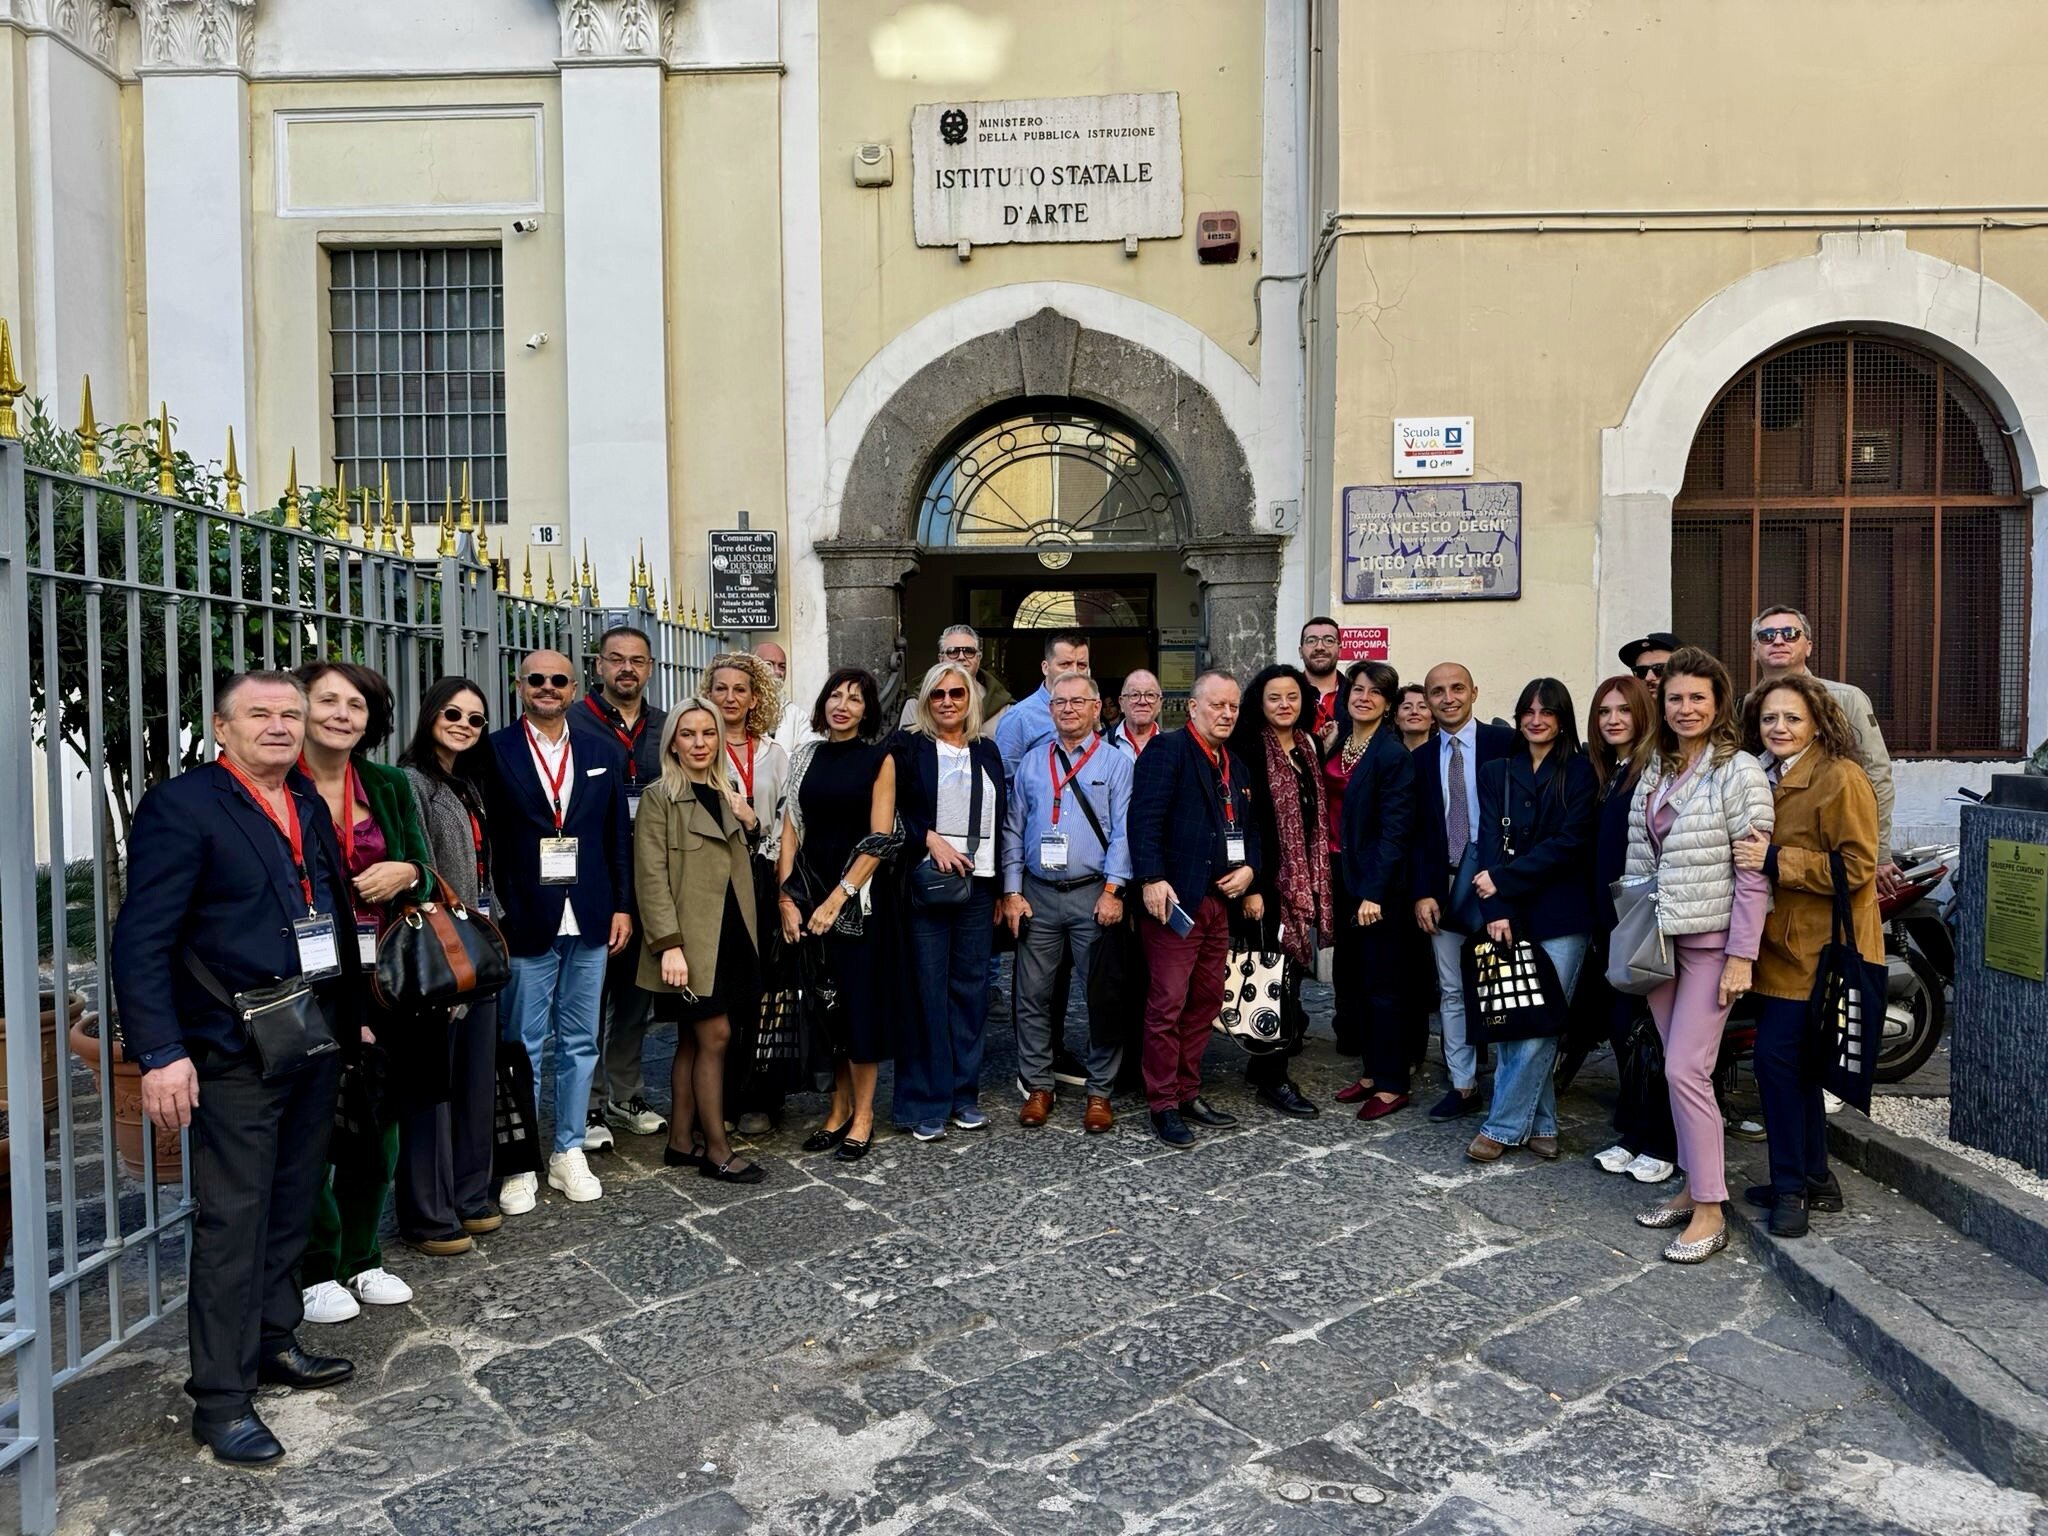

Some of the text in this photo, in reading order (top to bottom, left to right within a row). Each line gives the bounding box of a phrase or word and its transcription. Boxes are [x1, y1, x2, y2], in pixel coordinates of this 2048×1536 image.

[979, 117, 1043, 128] MINISTERO
[979, 127, 1156, 142] DELLA PUBBLICA ISTRUZIONE
[936, 163, 1153, 189] ISTITUTO STATALE
[1403, 427, 1439, 438] Scuola
[1404, 438, 1439, 449] Viva
[1275, 507, 1284, 528] 2
[540, 527, 552, 542] 18
[721, 534, 762, 542] Comune di
[712, 544, 772, 552] Torre del Greco
[728, 554, 774, 562] LIONS CLUB
[1360, 552, 1504, 571] LICEO ARTISTICO
[730, 562, 772, 570] DUE TORRI
[722, 615, 740, 624] Sec.
[1343, 630, 1381, 638] ATTACCO
[1340, 640, 1387, 648] UTOPOMPA
[1353, 651, 1369, 659] VVF
